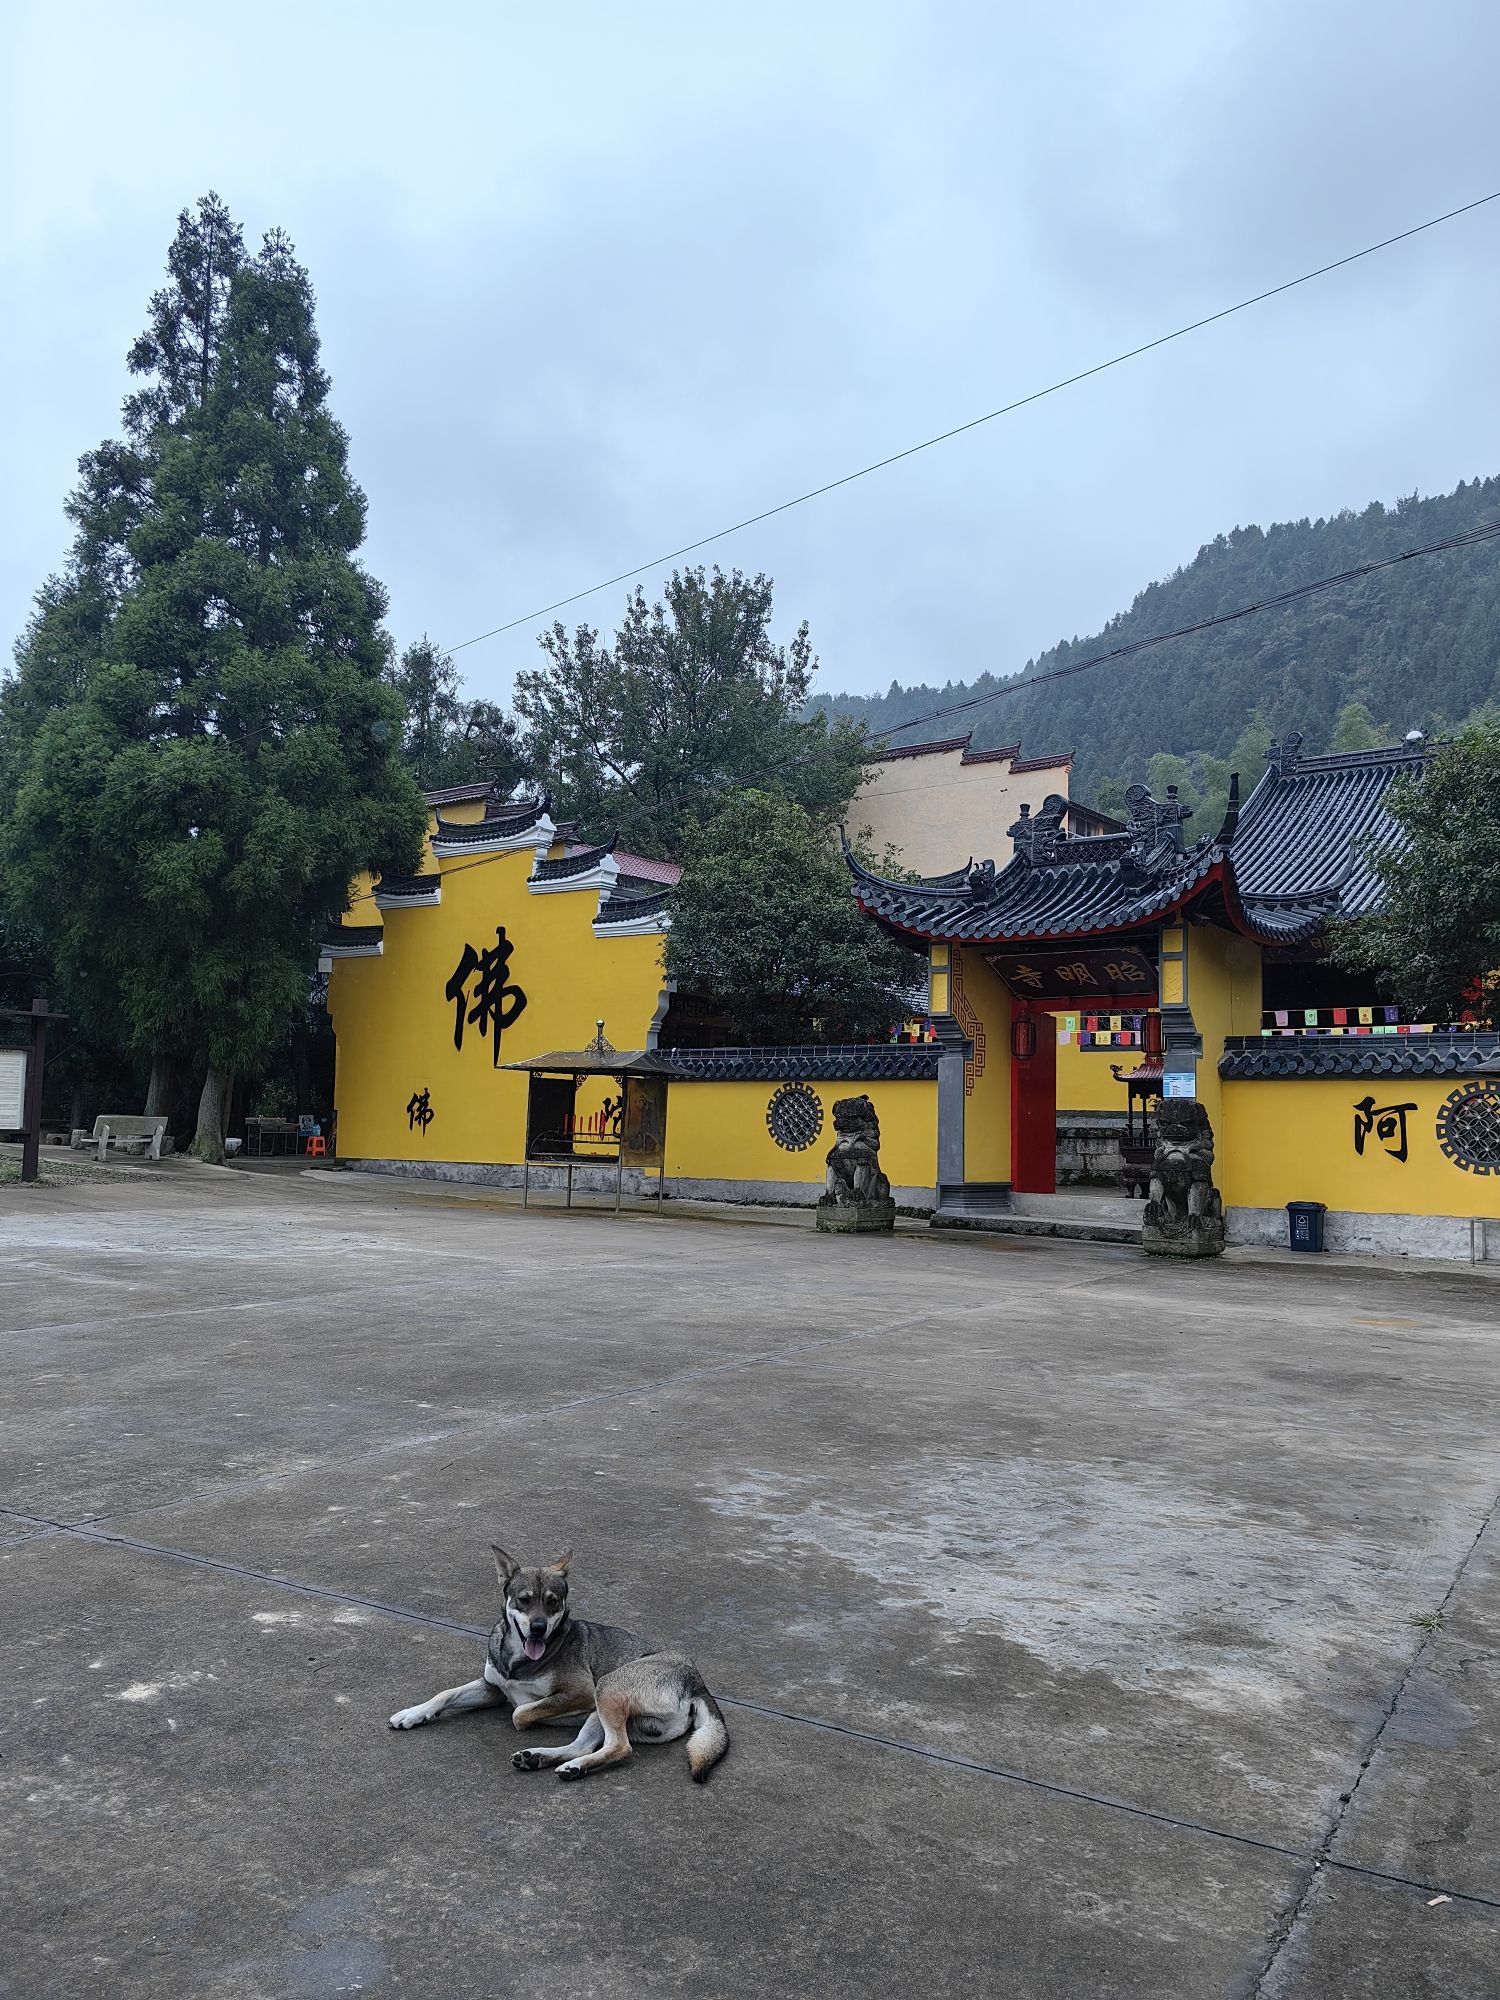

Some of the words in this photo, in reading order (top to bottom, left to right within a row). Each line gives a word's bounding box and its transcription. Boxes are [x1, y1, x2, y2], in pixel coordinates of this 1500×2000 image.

[446, 927, 527, 1066] 佛
[407, 1088, 434, 1137] 佛
[1353, 1097, 1418, 1163] 阿
